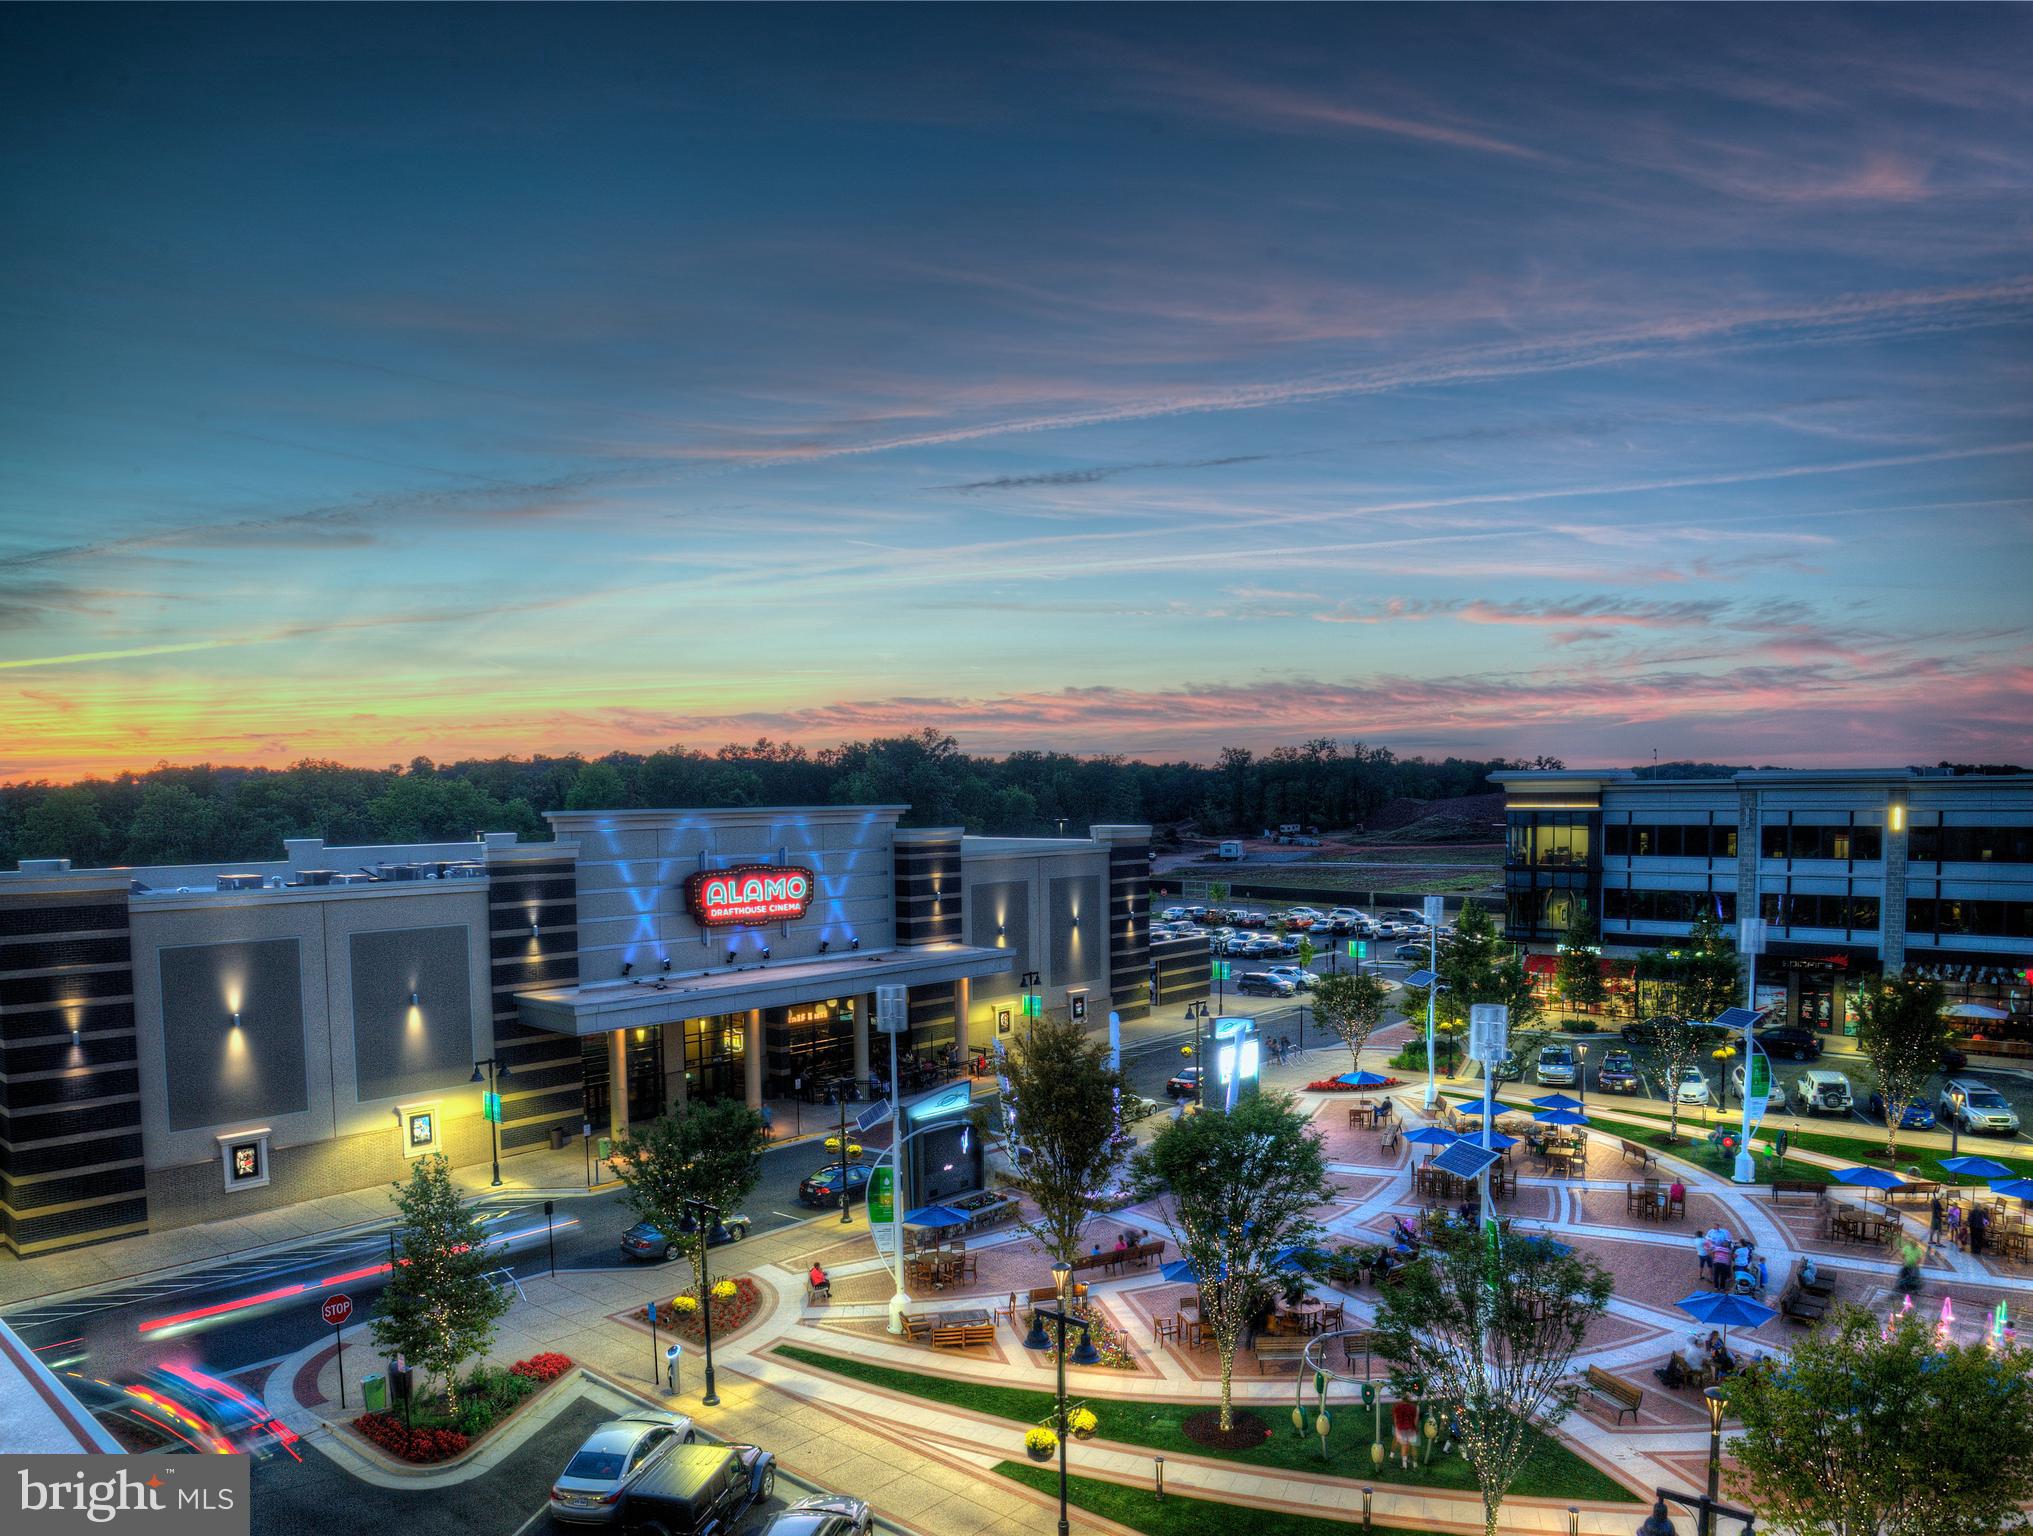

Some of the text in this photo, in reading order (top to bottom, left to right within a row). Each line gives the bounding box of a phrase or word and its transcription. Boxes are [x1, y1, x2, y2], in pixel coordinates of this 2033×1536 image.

[706, 876, 807, 906] ALAMO
[711, 903, 801, 917] DRAFTHOUSE CINEMA
[324, 1301, 351, 1318] STOP
